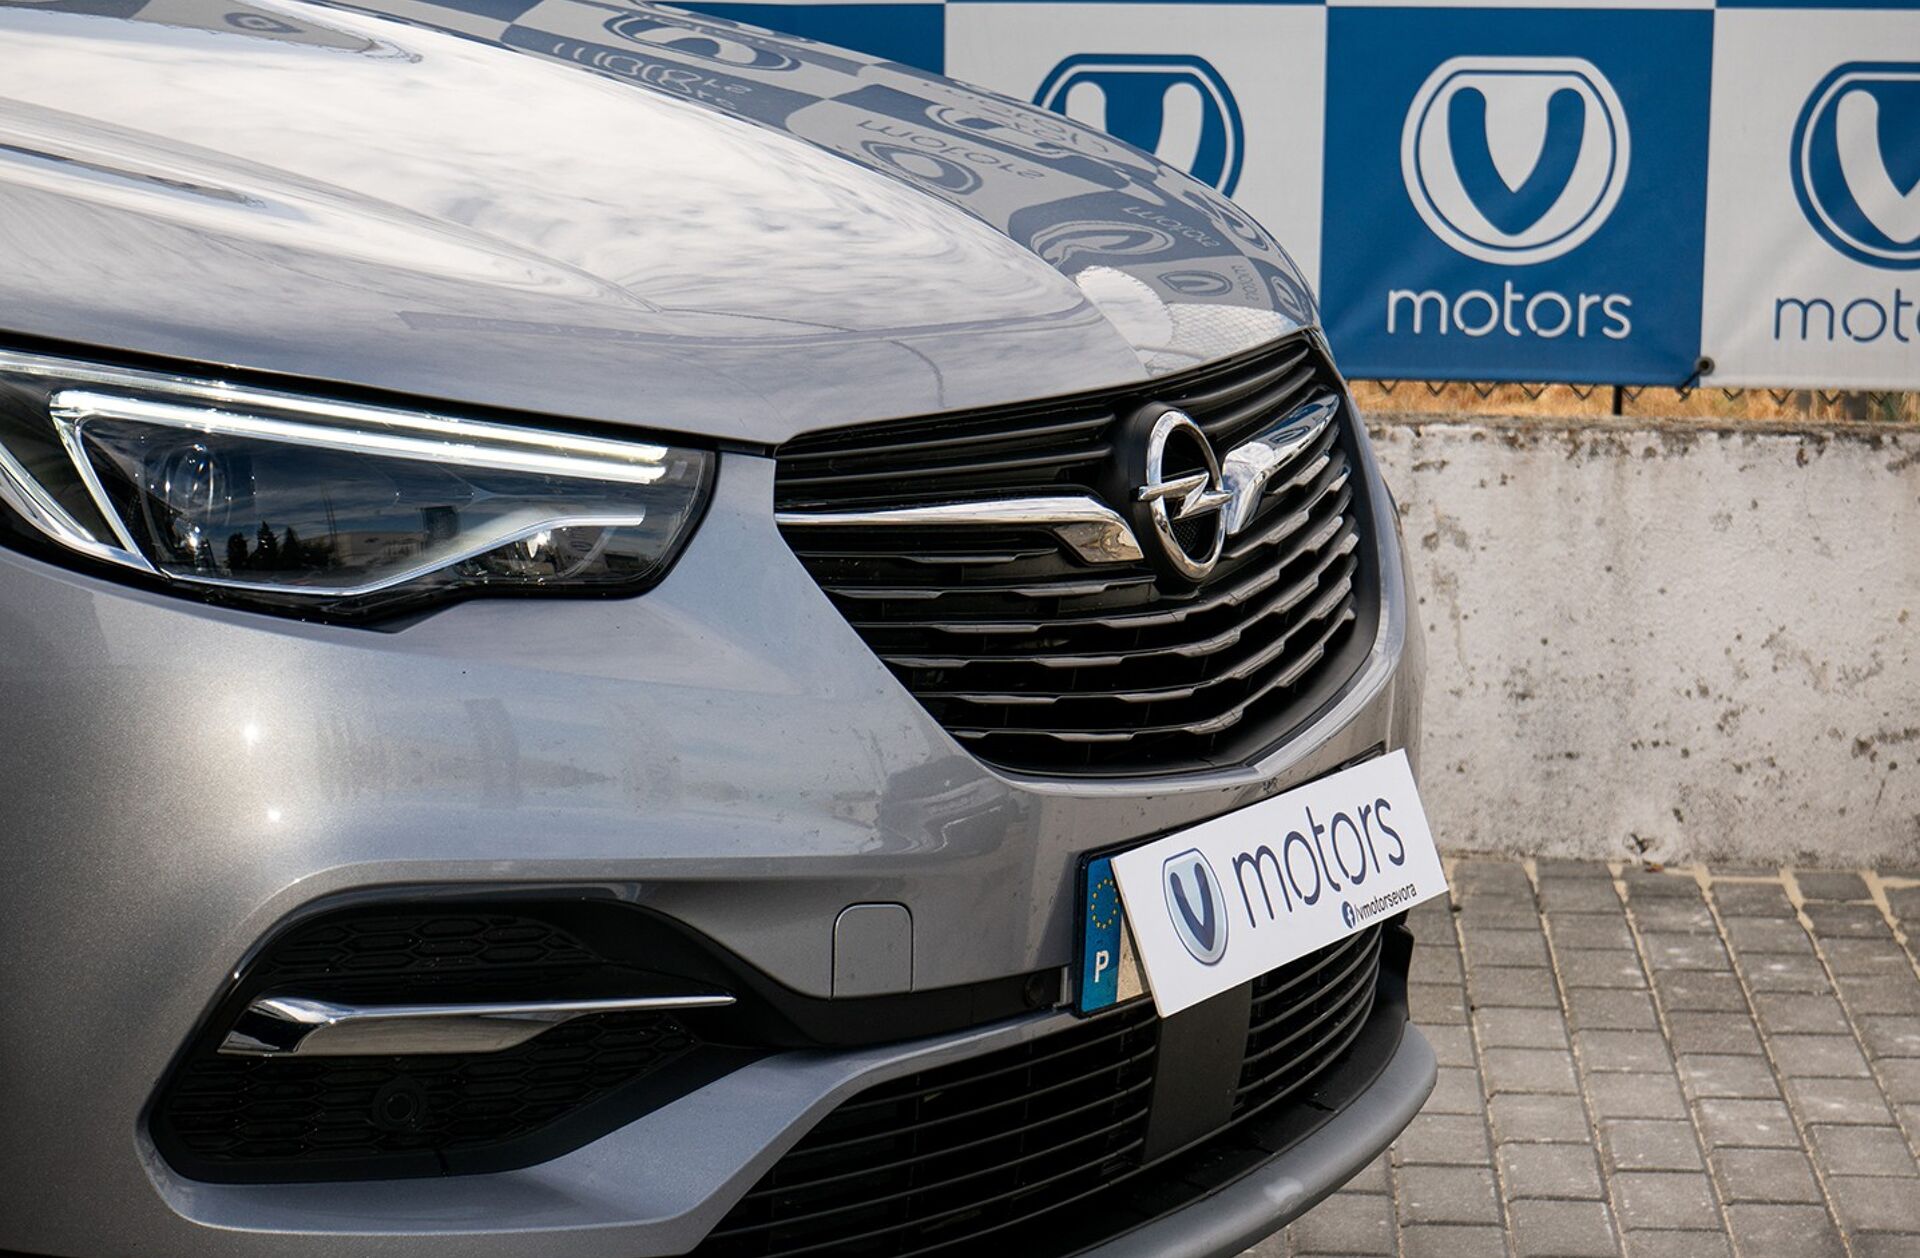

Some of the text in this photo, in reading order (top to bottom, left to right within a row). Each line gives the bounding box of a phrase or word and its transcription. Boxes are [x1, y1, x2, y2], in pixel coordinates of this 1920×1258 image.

[1386, 279, 1632, 340] motors
[1774, 288, 1920, 343] mot
[1231, 797, 1405, 929] motors
[1093, 948, 1110, 983] P
